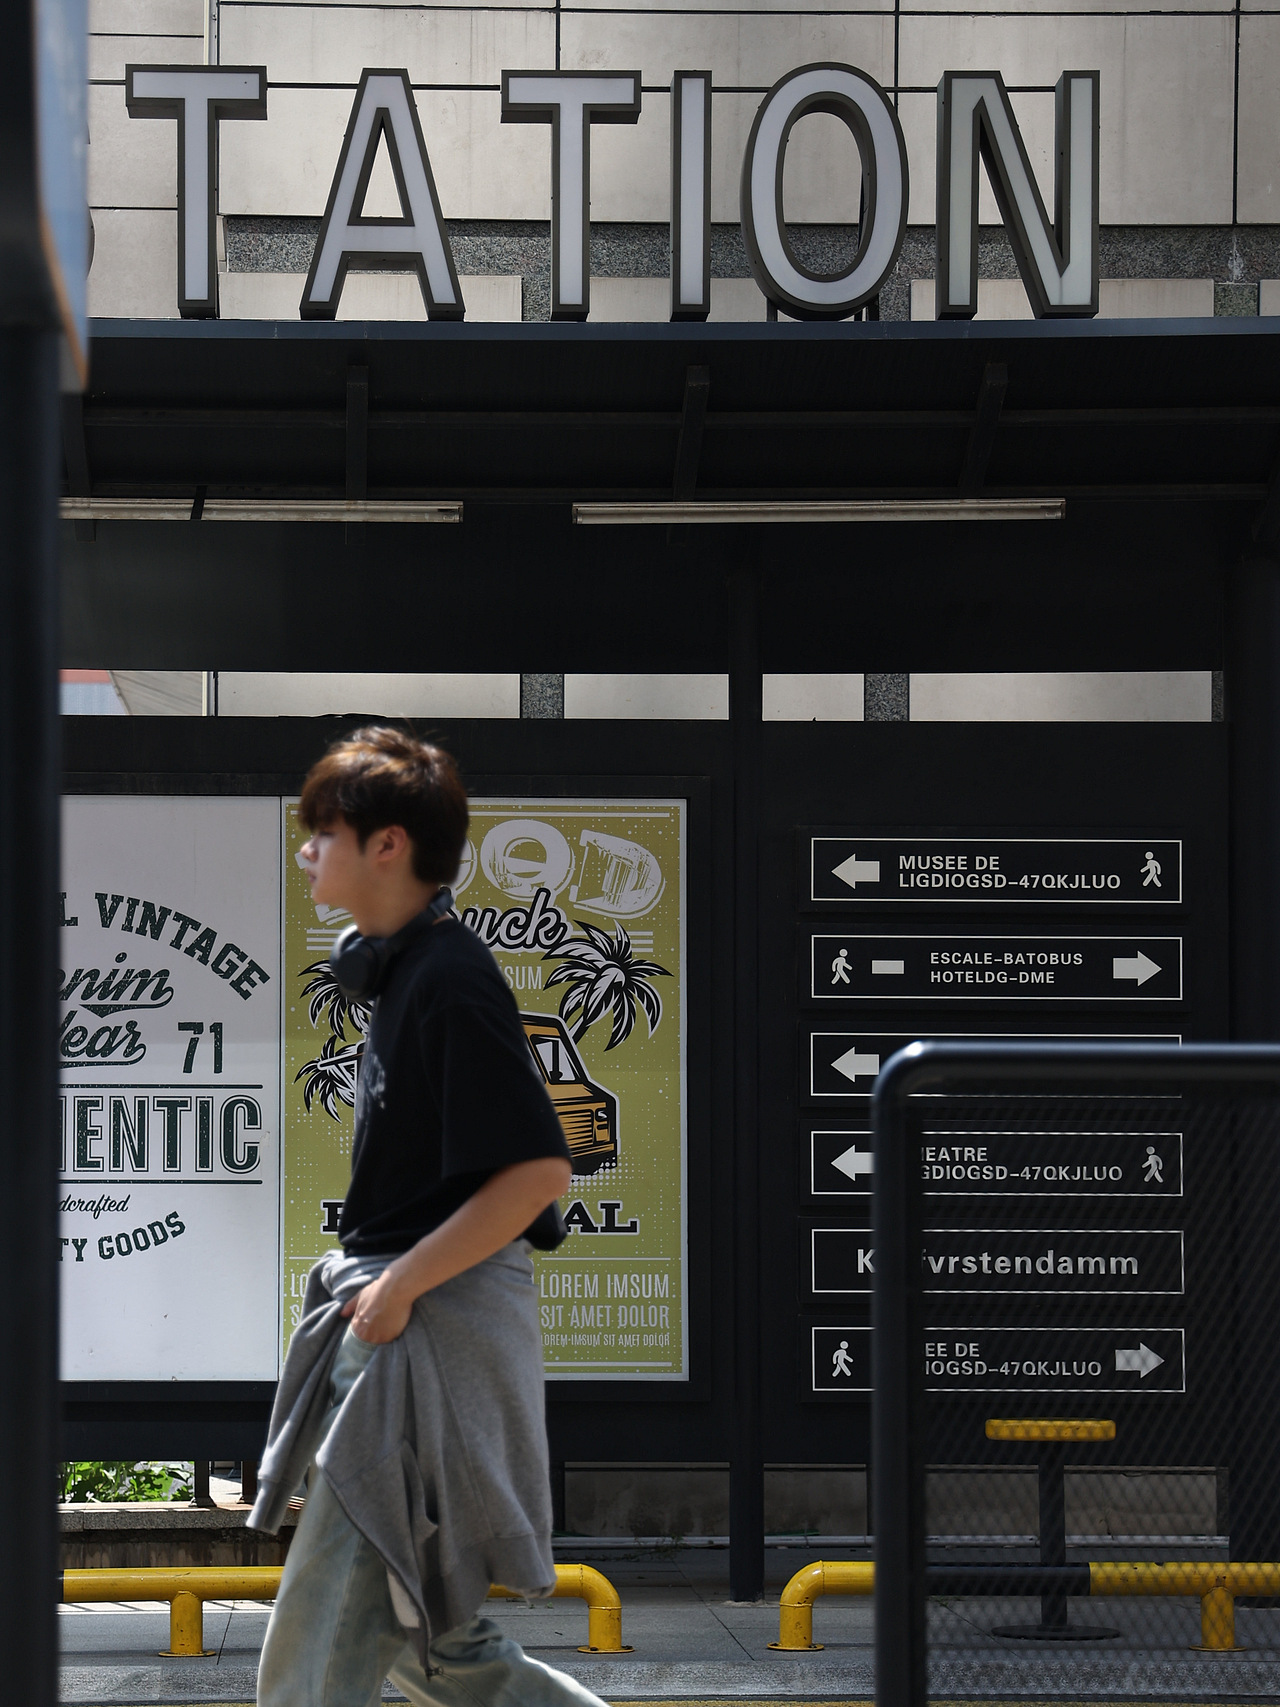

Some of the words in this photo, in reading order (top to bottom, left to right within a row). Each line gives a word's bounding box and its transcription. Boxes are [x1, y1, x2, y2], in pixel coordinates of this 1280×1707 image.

[86, 62, 1101, 321] TATION
[899, 855, 968, 870] MUSEE
[975, 857, 1000, 870] DE
[462, 888, 575, 950] uck
[94, 892, 271, 1001] VINTAGE
[498, 965, 543, 990] SUM
[58, 1010, 147, 1064] ear
[177, 1021, 224, 1074] 71
[58, 1094, 262, 1174] ENTIC
[58, 1194, 131, 1220] dcrafted
[98, 1211, 186, 1260] GOODS
[540, 1273, 599, 1299] LOREM
[607, 1273, 669, 1299] IMSUM
[540, 1304, 564, 1328] SIT
[570, 1304, 612, 1328] AMET
[617, 1304, 670, 1328] DOLOR
[925, 1343, 948, 1357] EE
[955, 1343, 980, 1357] DE
